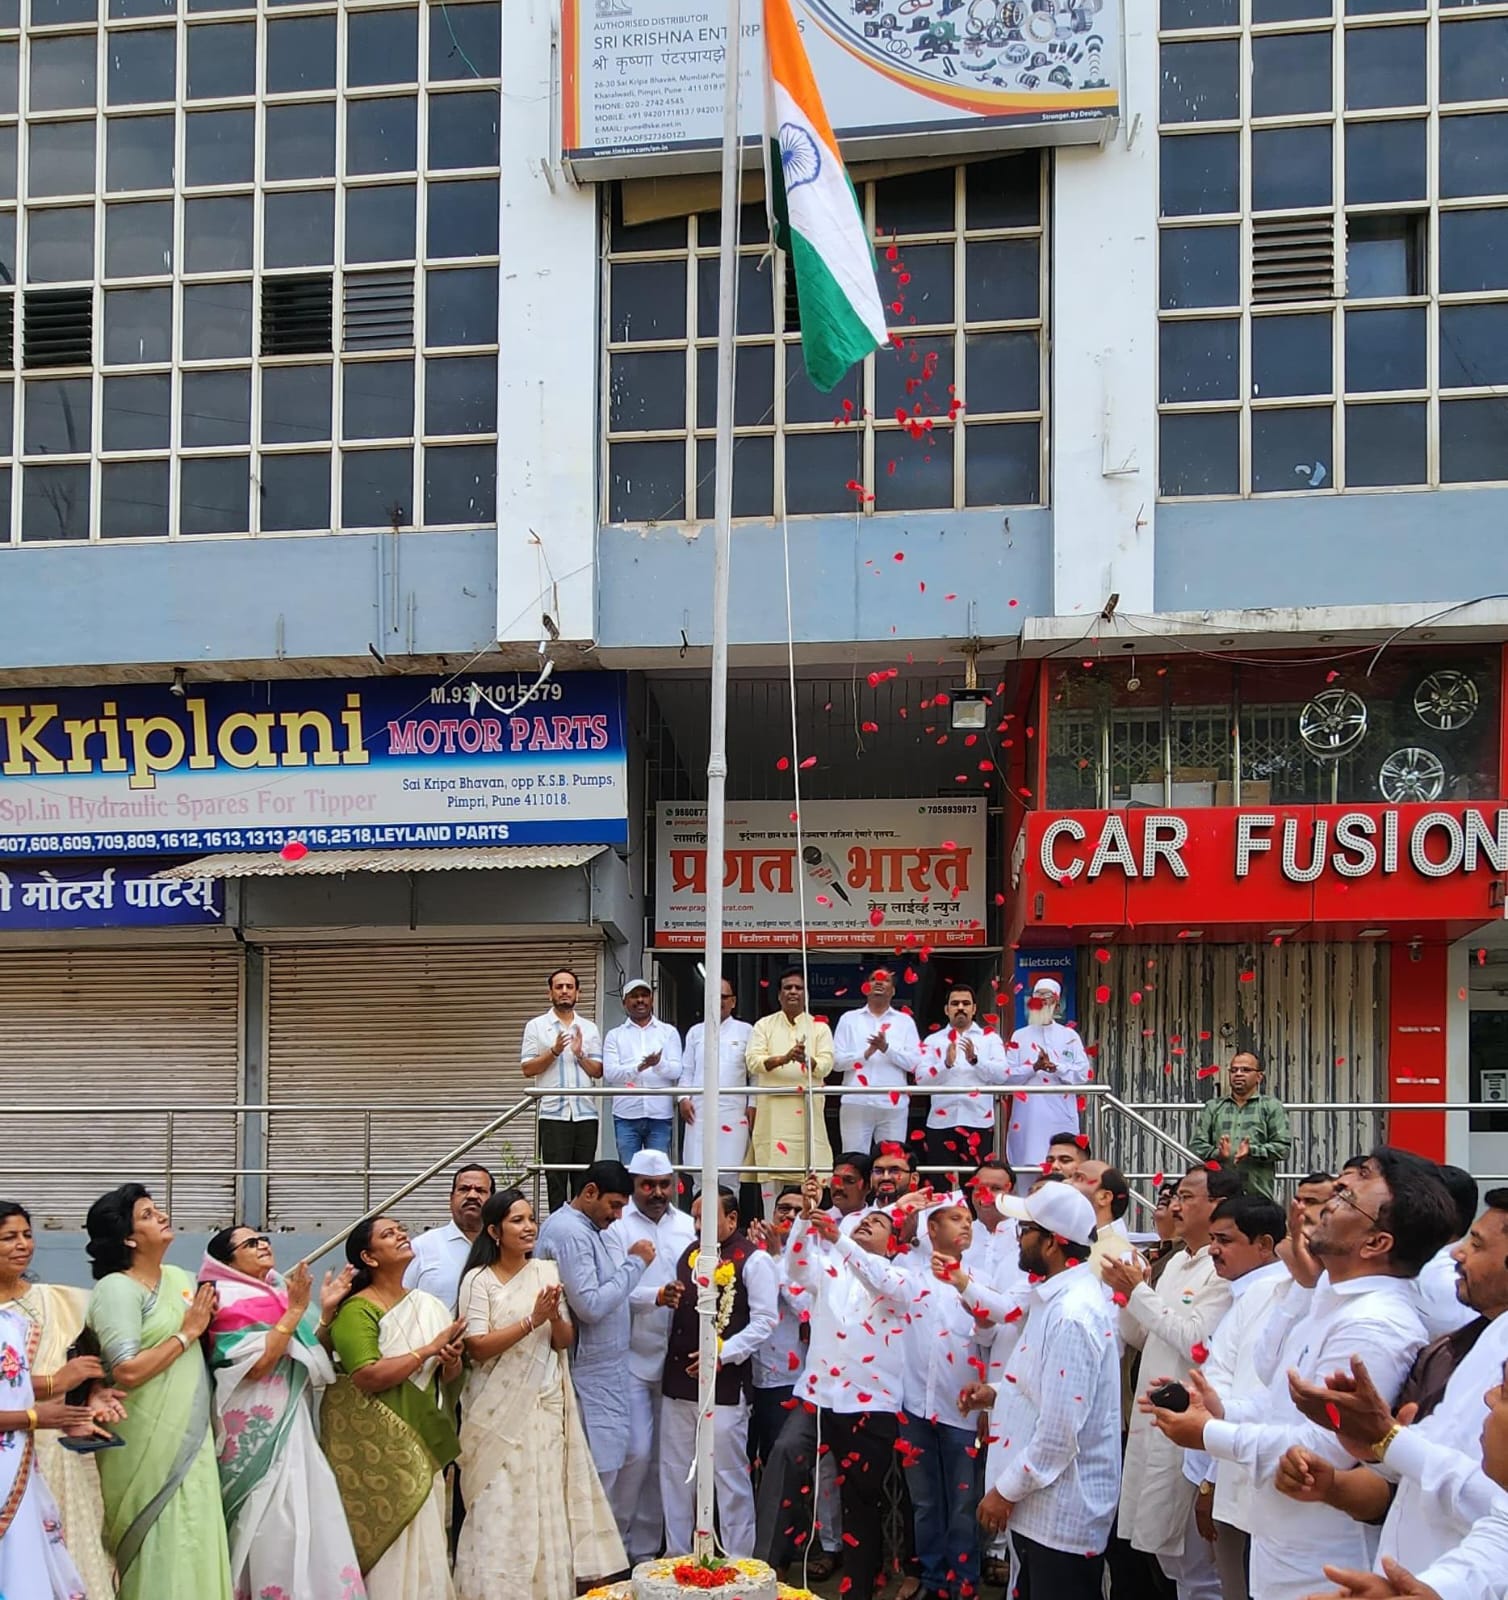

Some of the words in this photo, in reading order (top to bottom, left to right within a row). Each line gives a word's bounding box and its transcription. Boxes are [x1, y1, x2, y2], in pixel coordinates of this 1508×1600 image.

[594, 19, 650, 31] AUTHORISED
[651, 14, 709, 26] DISTRIBUTOR
[594, 36, 618, 50] SRI
[623, 30, 694, 48] KRISHNA
[592, 54, 609, 71] श्री
[616, 54, 654, 75] कृष्णा
[594, 102, 624, 111] PHONE:
[625, 101, 640, 109] 020
[646, 99, 664, 107] 2742
[665, 97, 685, 105] 4545
[594, 113, 625, 123] MOBILE:
[594, 136, 611, 145] GST:
[0, 692, 371, 791] Kriplani
[387, 718, 502, 755] MOTOR
[510, 715, 608, 752] PARTS
[402, 778, 421, 791] Sai
[424, 777, 456, 793] Kripa
[459, 776, 508, 791] Bhavan,
[511, 778, 534, 791] opp
[537, 774, 569, 787] K.S.B.
[572, 773, 616, 788] Pumps,
[69, 792, 169, 825] Hydraulic
[177, 793, 254, 821] Spares
[257, 790, 295, 814] For
[304, 788, 377, 817] Tipper
[447, 796, 489, 810] Pimpri,
[491, 794, 521, 807] Pune
[524, 792, 571, 806] 411018.
[456, 823, 510, 841] PARTS
[672, 831, 708, 844] साप्ताहि
[1040, 814, 1189, 882] CAR
[1236, 808, 1508, 882] FUSION
[669, 850, 797, 894] प्रगत
[847, 846, 973, 893] भारत
[1028, 955, 1072, 967] letstrack
